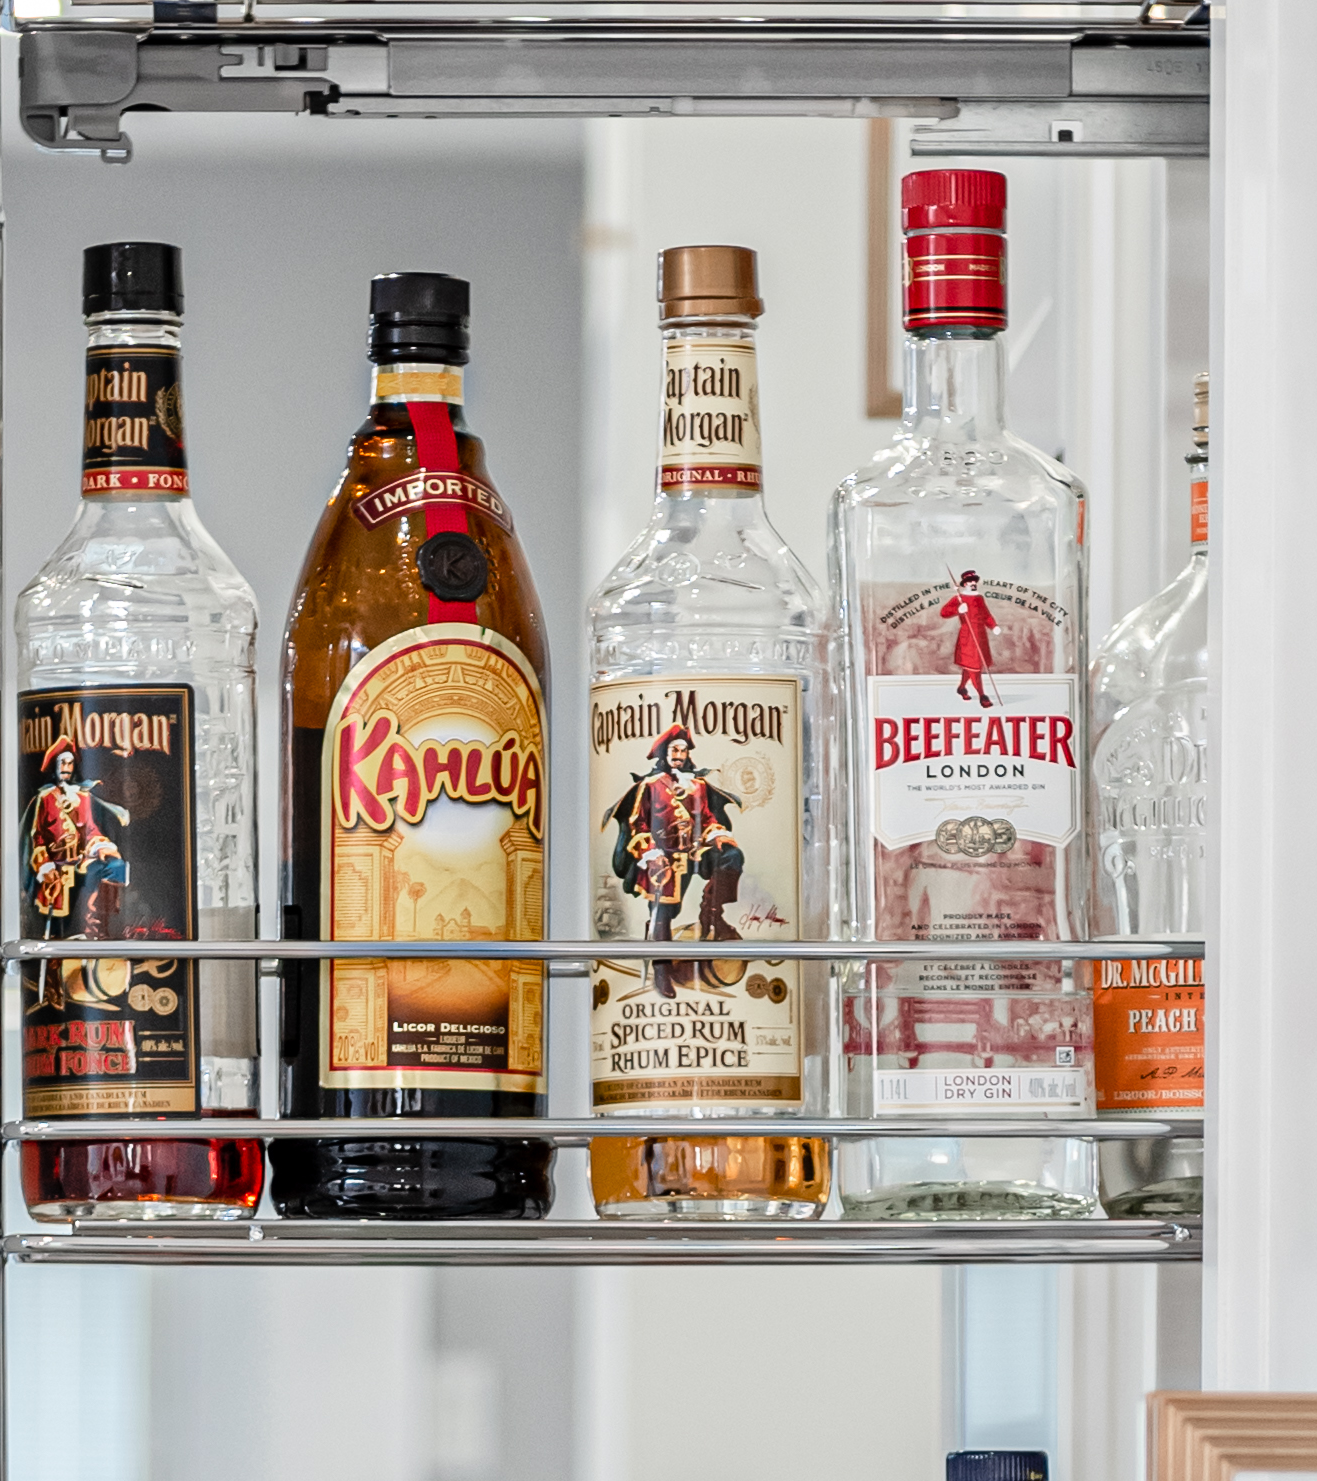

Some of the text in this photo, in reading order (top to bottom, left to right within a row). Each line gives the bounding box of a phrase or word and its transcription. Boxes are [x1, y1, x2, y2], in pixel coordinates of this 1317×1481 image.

[373, 478, 504, 516] IMPORTED
[880, 578, 1070, 625] DISTILLED IN THE HEART OF THE CITY
[927, 596, 941, 608] AU
[1014, 596, 1027, 607] DE
[1028, 601, 1040, 612] LA
[1041, 607, 1063, 627] VILLE
[53, 701, 171, 758] Morgan
[591, 689, 785, 756] Captain Morgan
[874, 716, 1078, 771] BEEFEATER
[337, 713, 544, 840] KAHLÚA
[926, 764, 1026, 779] LONDON
[907, 783, 1046, 792] THE WORLD'S MOST AWARDED GIN
[914, 933, 973, 941] RECOGNIZED
[1004, 922, 1042, 930] LONDON
[622, 1001, 731, 1020] ORIGINAL
[1128, 1008, 1198, 1034] PEACH
[68, 1020, 135, 1050] RUM
[392, 1021, 506, 1035] LICOR DELICIOSO
[610, 1019, 749, 1051] SPICED RUM
[337, 1034, 381, 1063] 20% vol
[611, 1038, 750, 1074] RHUM ÉPICÉ
[880, 1078, 901, 1100] 1.14
[944, 1087, 977, 1100] DRY
[983, 1087, 1013, 1099] GIN
[1029, 1077, 1045, 1098] 40%
[944, 1075, 1012, 1087] LONDON
